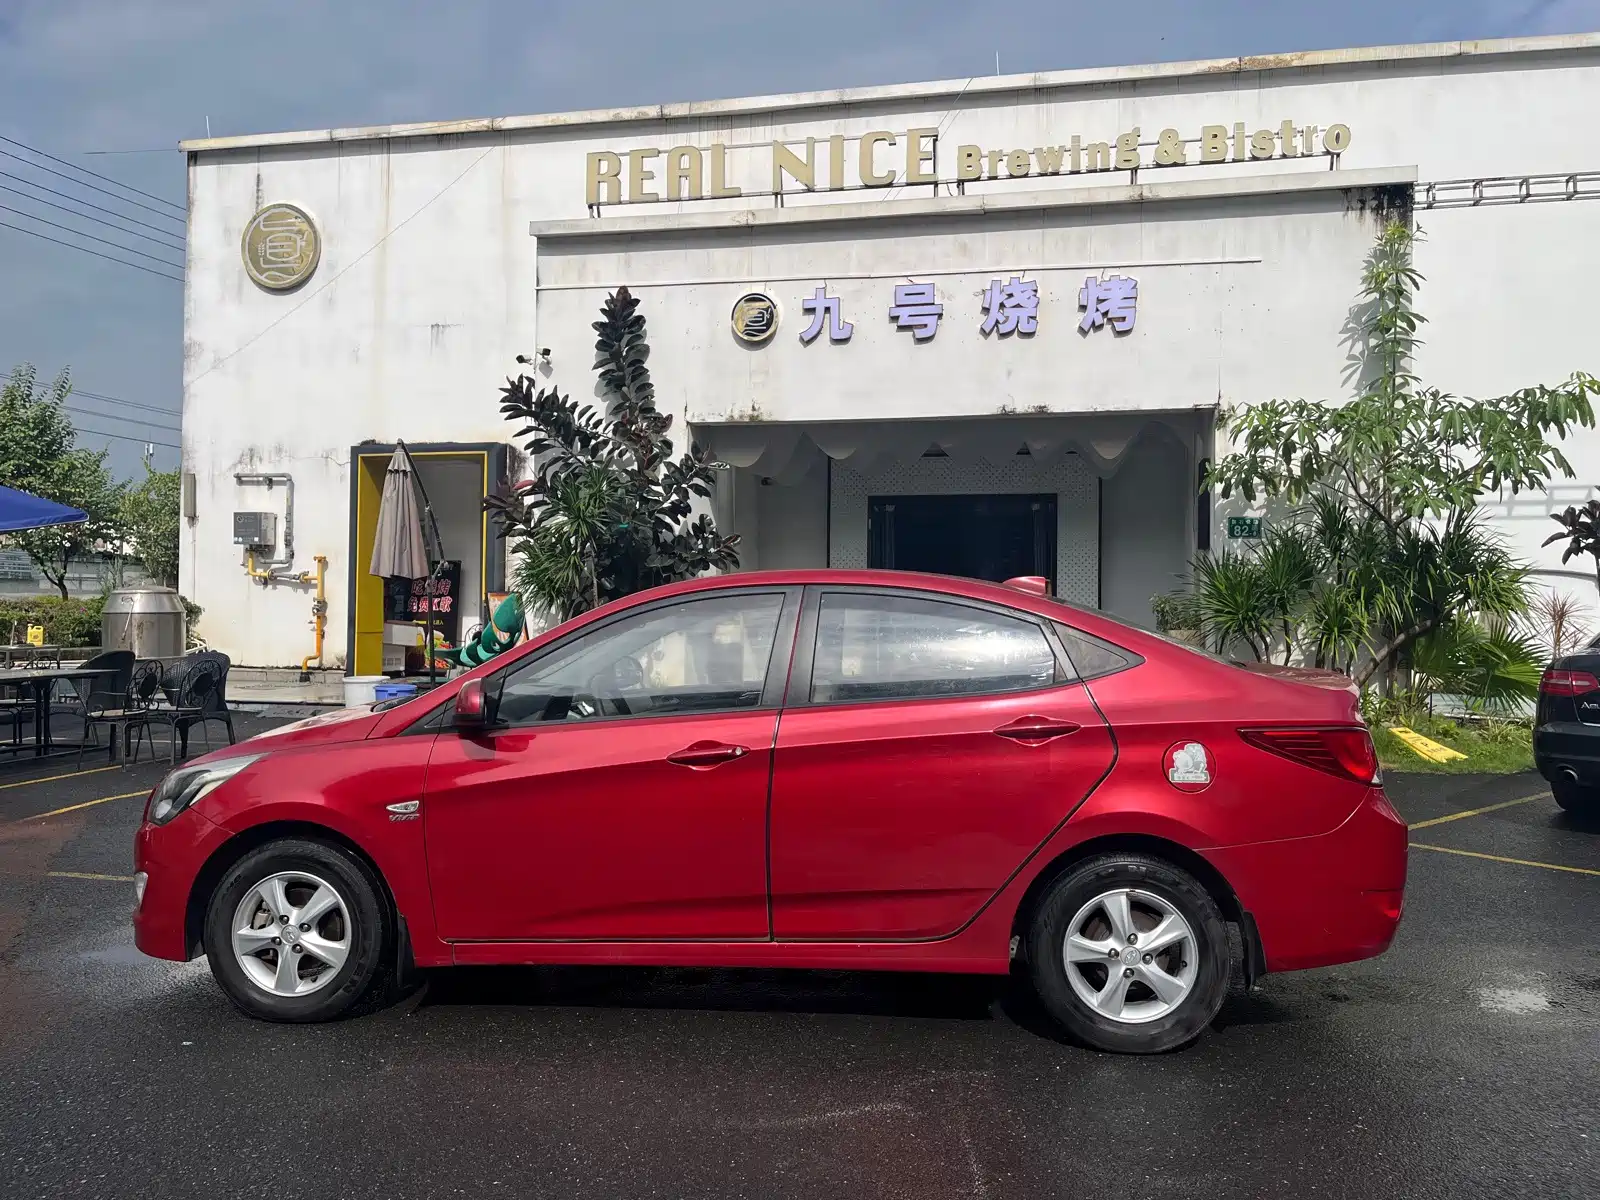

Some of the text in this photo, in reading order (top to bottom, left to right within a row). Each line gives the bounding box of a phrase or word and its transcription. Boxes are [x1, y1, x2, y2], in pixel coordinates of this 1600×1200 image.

[586, 119, 1352, 205] REAL NICE Brewing & Bistro
[799, 274, 1139, 343] 九号烧烤
